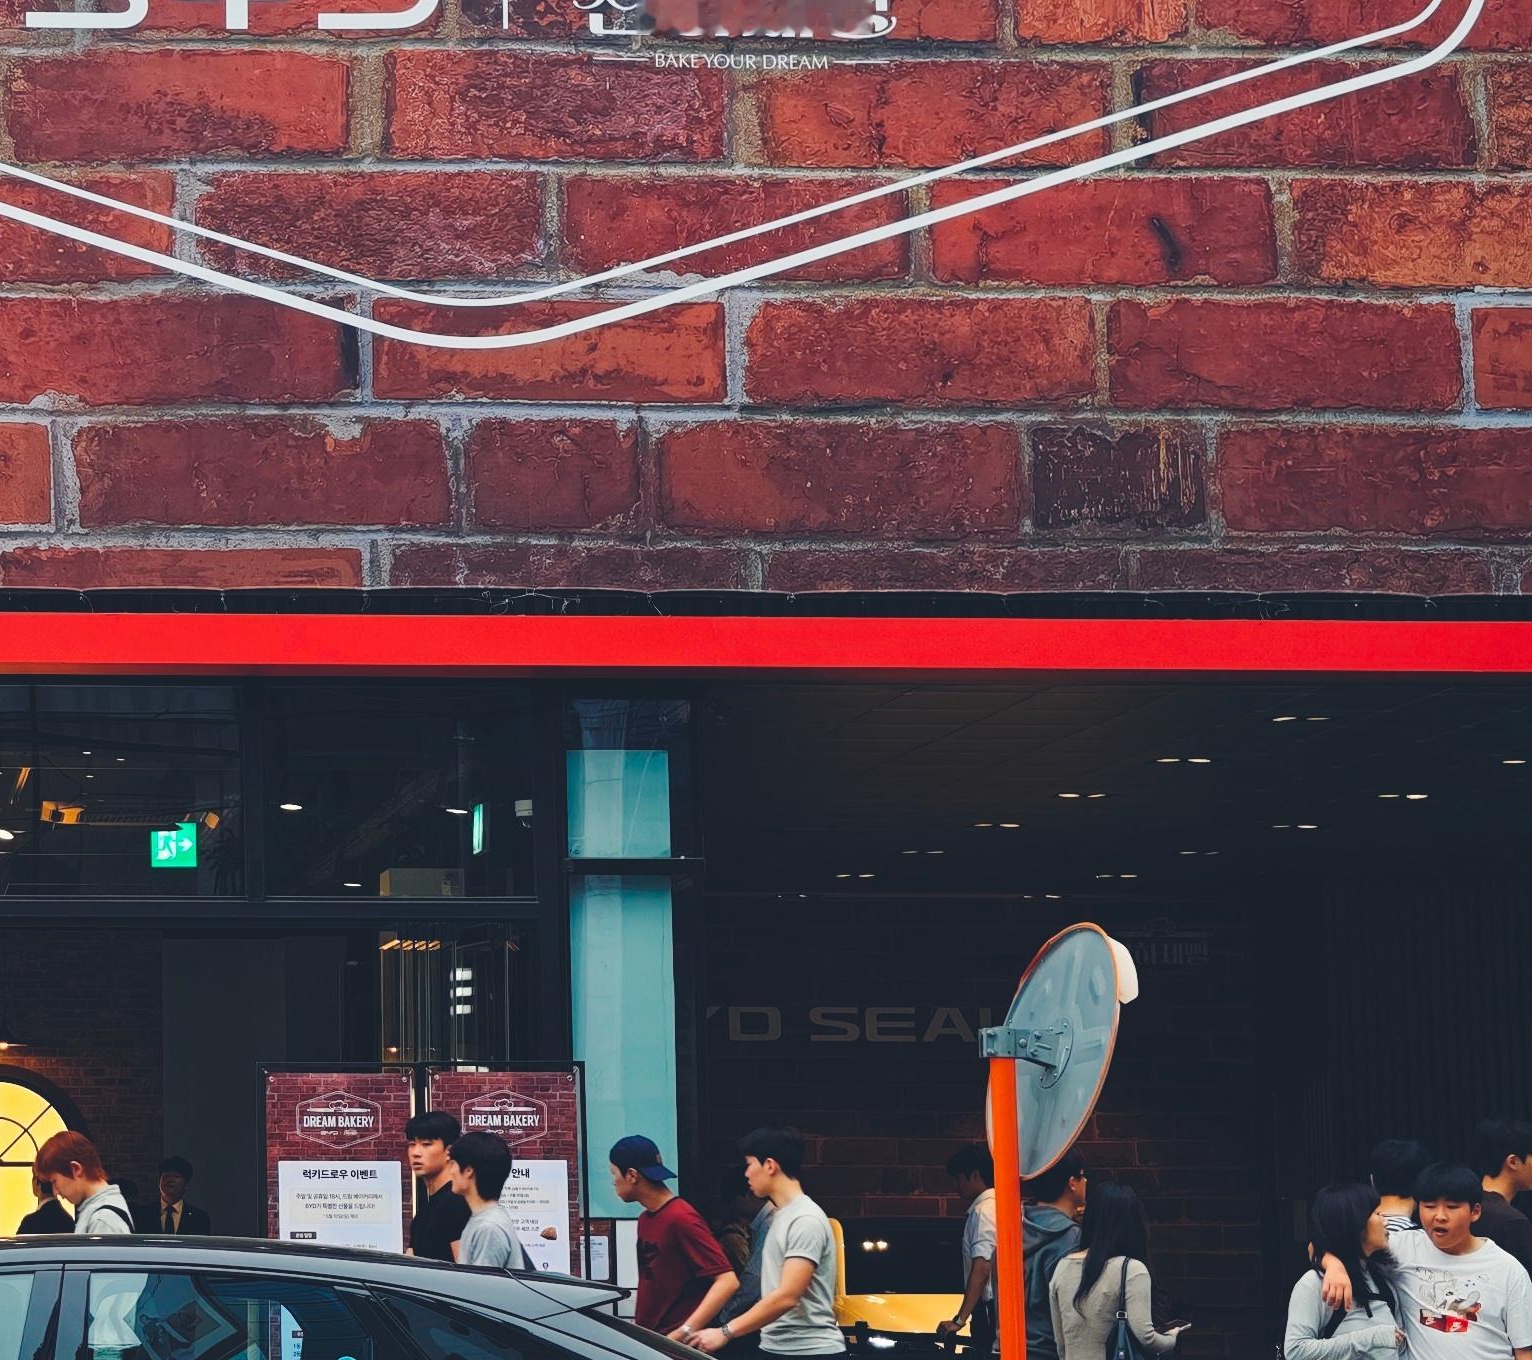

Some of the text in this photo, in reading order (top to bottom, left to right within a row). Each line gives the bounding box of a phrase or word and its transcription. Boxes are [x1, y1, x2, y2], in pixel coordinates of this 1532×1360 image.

[654, 53, 828, 70] BAKE YOUR DREAM
[303, 1115, 374, 1128] DREAM BAKERY
[468, 1115, 540, 1127] DREAM BAKERY
[302, 1169, 379, 1180] 럭키드로우 이벤트
[511, 1168, 530, 1179] 안내
